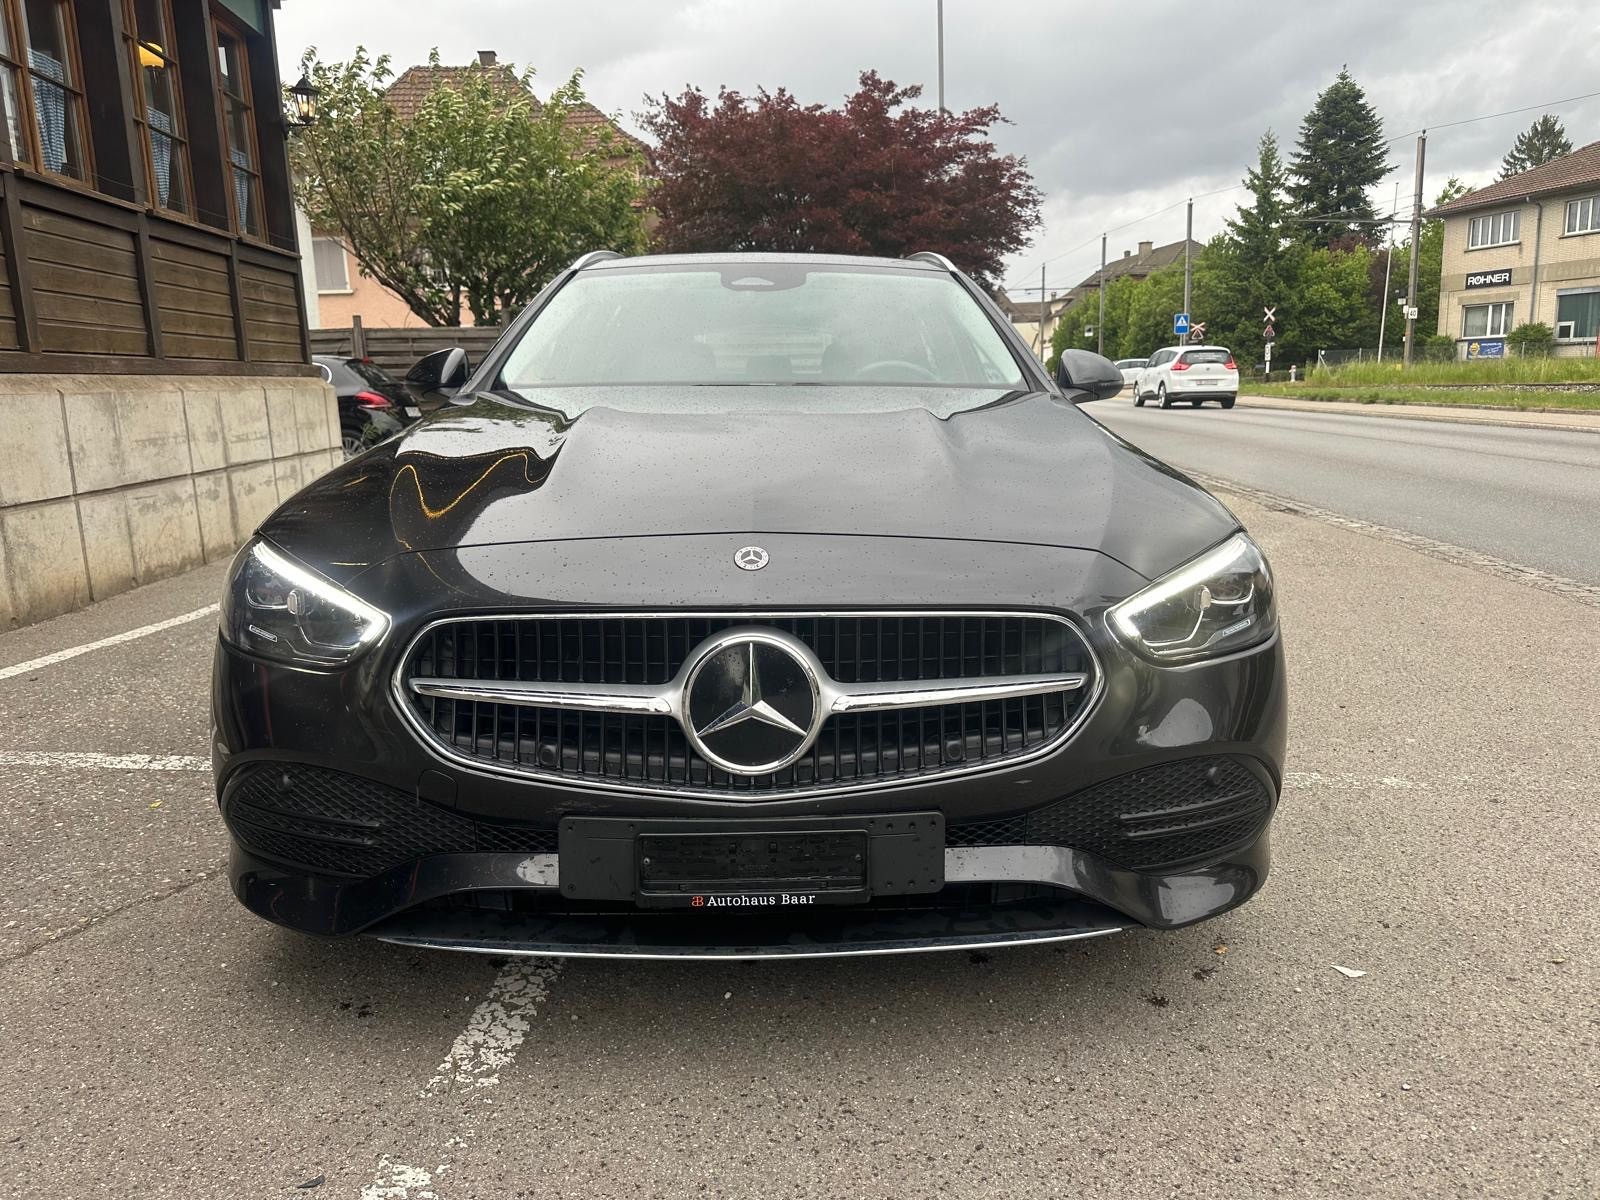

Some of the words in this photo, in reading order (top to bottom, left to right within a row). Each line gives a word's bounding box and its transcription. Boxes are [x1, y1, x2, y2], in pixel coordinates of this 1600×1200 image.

[1467, 273, 1509, 286] ROHNER
[707, 895, 776, 907] Autohaus
[781, 894, 816, 905] Baar
